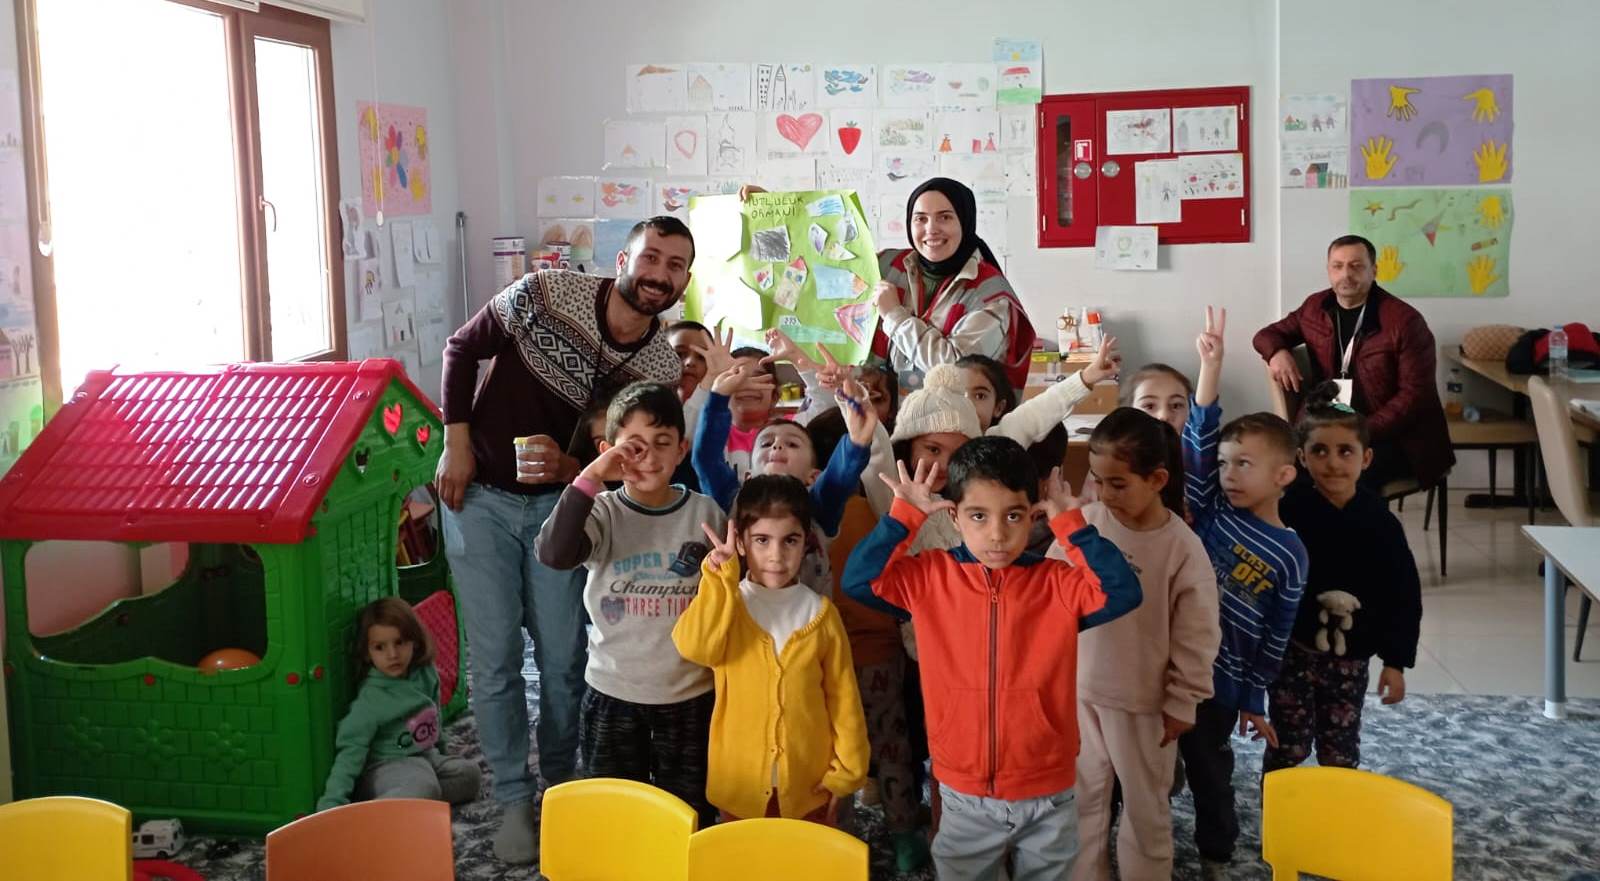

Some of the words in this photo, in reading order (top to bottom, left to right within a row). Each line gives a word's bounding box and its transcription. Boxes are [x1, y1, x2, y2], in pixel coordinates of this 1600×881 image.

[613, 552, 661, 576] SUPER
[1232, 544, 1272, 575] BLAST
[1231, 562, 1274, 594] OFF
[625, 598, 660, 617] THREE
[667, 596, 693, 617] TIM
